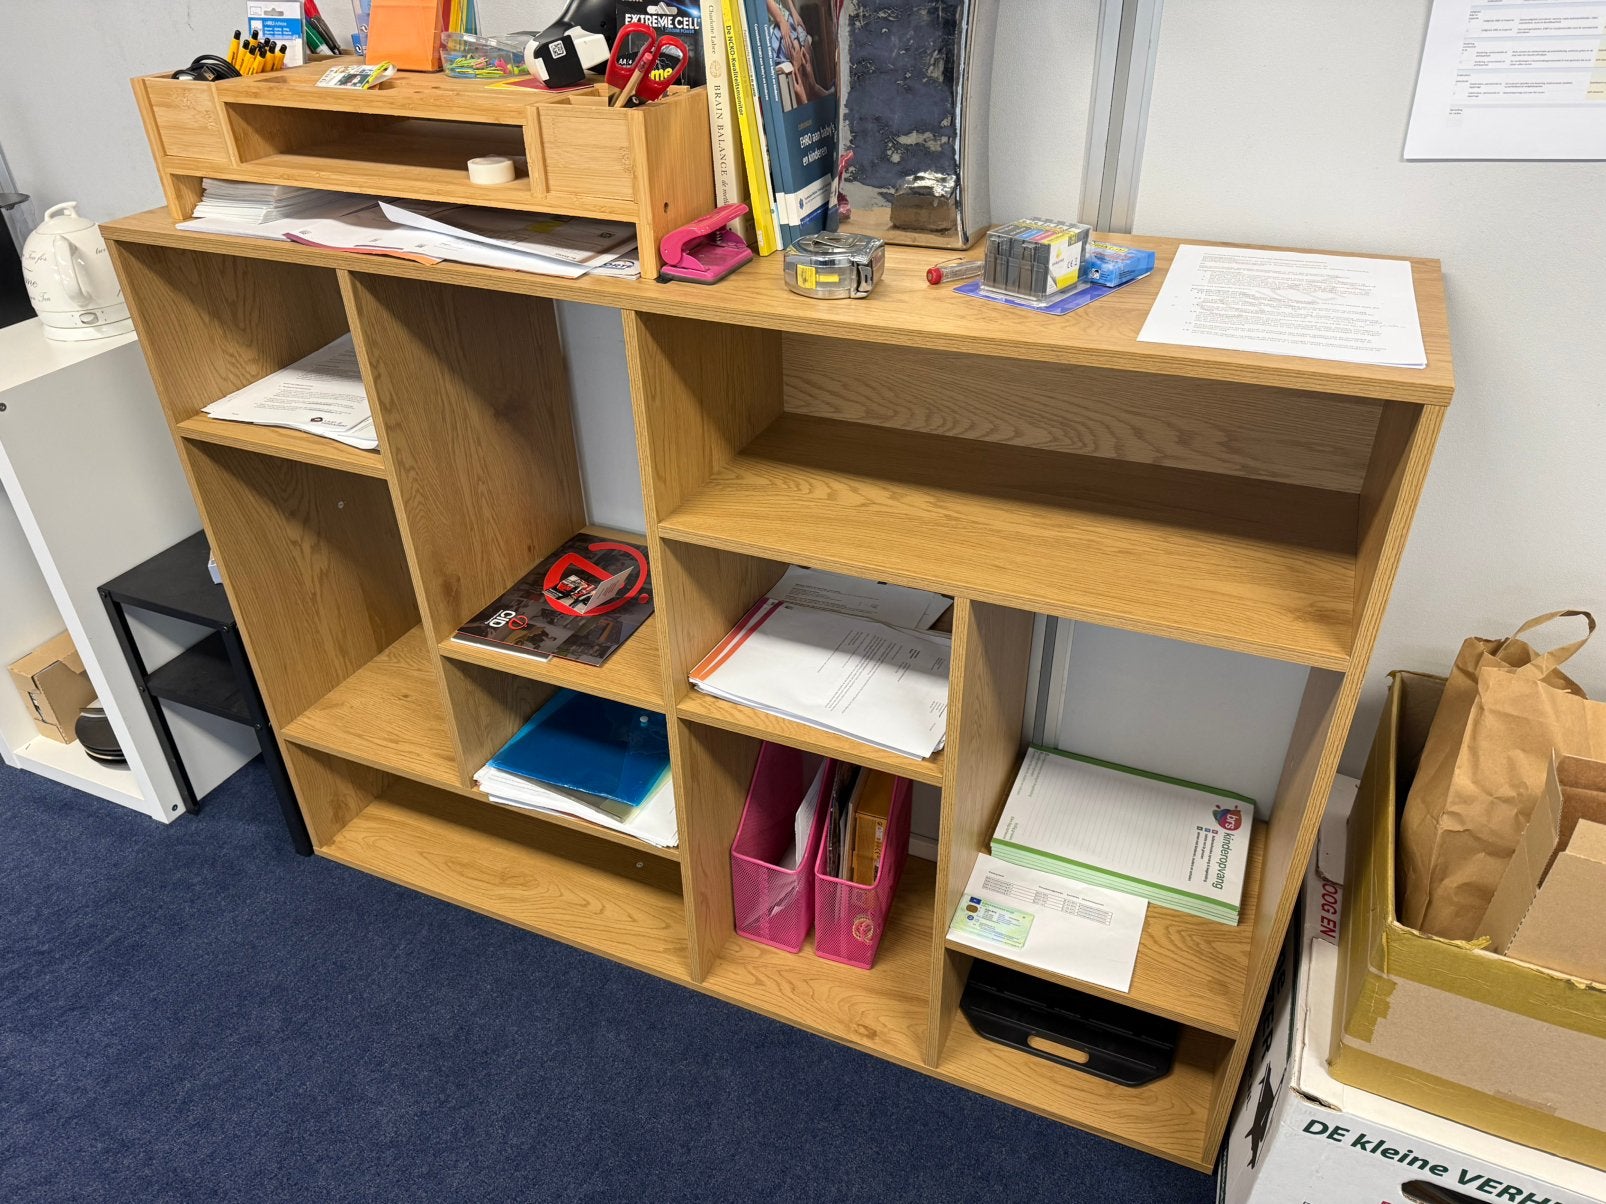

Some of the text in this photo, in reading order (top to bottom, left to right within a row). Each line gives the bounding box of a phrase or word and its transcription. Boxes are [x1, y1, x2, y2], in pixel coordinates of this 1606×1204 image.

[625, 14, 700, 30] EXTREME CELL
[726, 26, 744, 116] De NCKO-Kwaliteitsmonitor
[714, 85, 724, 120] BRAIN
[717, 124, 728, 176] BALANCE
[800, 133, 812, 148] EHBO
[812, 131, 820, 142] aan
[820, 123, 835, 138] baby's
[802, 146, 828, 166] en kinderen
[489, 610, 516, 628] CID
[1212, 814, 1239, 890] brs kinderopvang
[1320, 880, 1338, 938] OOG EN
[1302, 1118, 1563, 1204] DE kleine VERH
